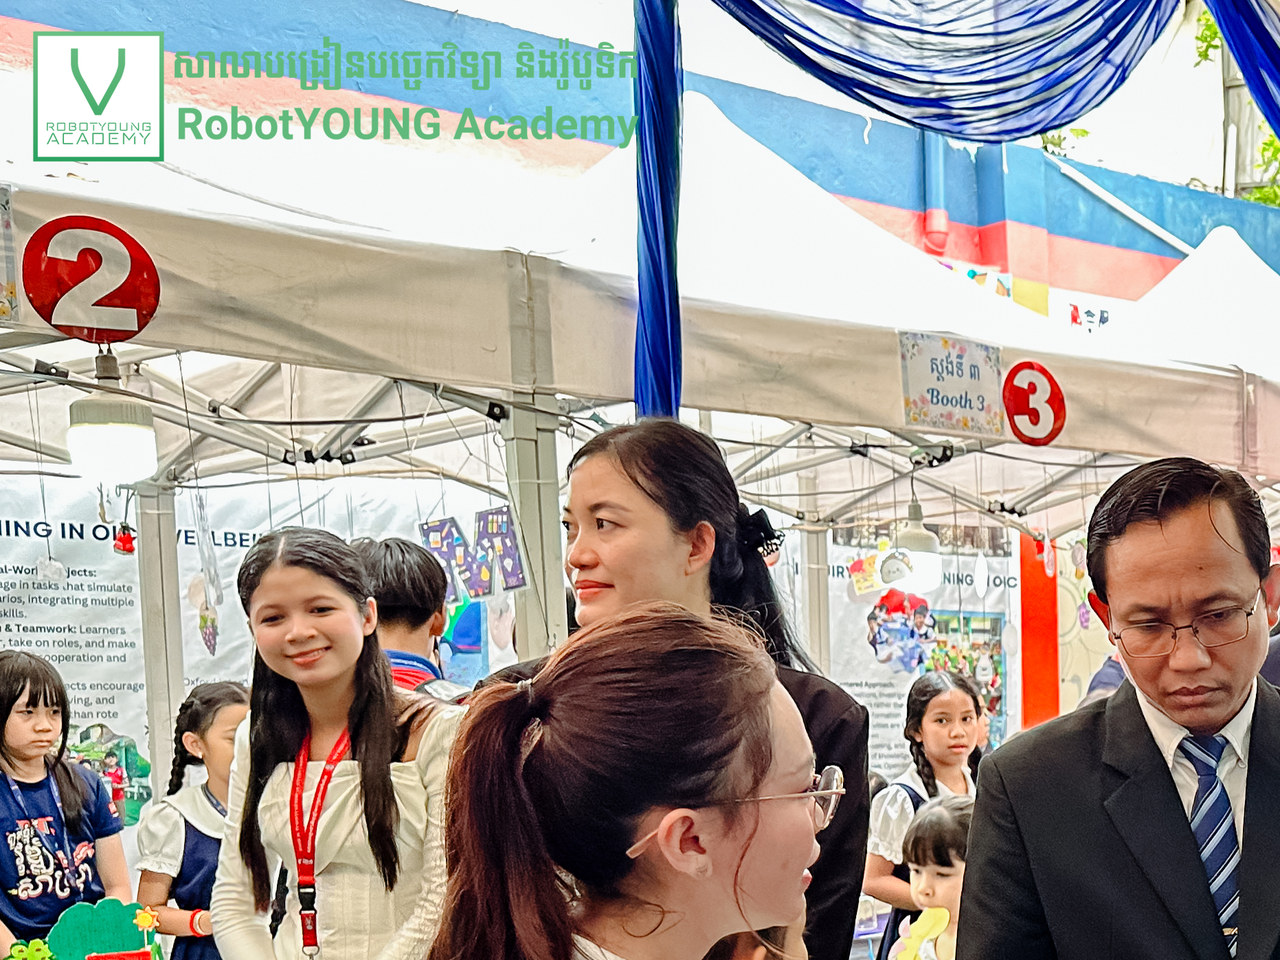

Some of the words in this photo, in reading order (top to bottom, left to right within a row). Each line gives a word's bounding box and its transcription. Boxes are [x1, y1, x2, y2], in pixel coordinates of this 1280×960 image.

[48, 227, 138, 331] 2
[927, 388, 973, 411] Booth
[977, 394, 985, 411] 3
[1013, 369, 1055, 439] 3
[0, 520, 52, 538] ING
[61, 523, 84, 539] IN
[92, 525, 118, 541] OI
[942, 574, 974, 586] NING
[32, 581, 59, 590] tasks
[87, 583, 133, 593] simulate
[28, 594, 88, 608] integrating
[90, 597, 135, 608] multiple
[5, 624, 12, 633] &
[15, 624, 76, 633] Teamwork:
[80, 625, 126, 635] Learners
[9, 638, 32, 647] take
[53, 639, 82, 649] roles,
[85, 639, 104, 648] and
[107, 640, 136, 648] make
[44, 653, 103, 664] ooperation
[107, 653, 126, 662] and
[90, 682, 145, 692] encourage
[96, 695, 115, 704] and
